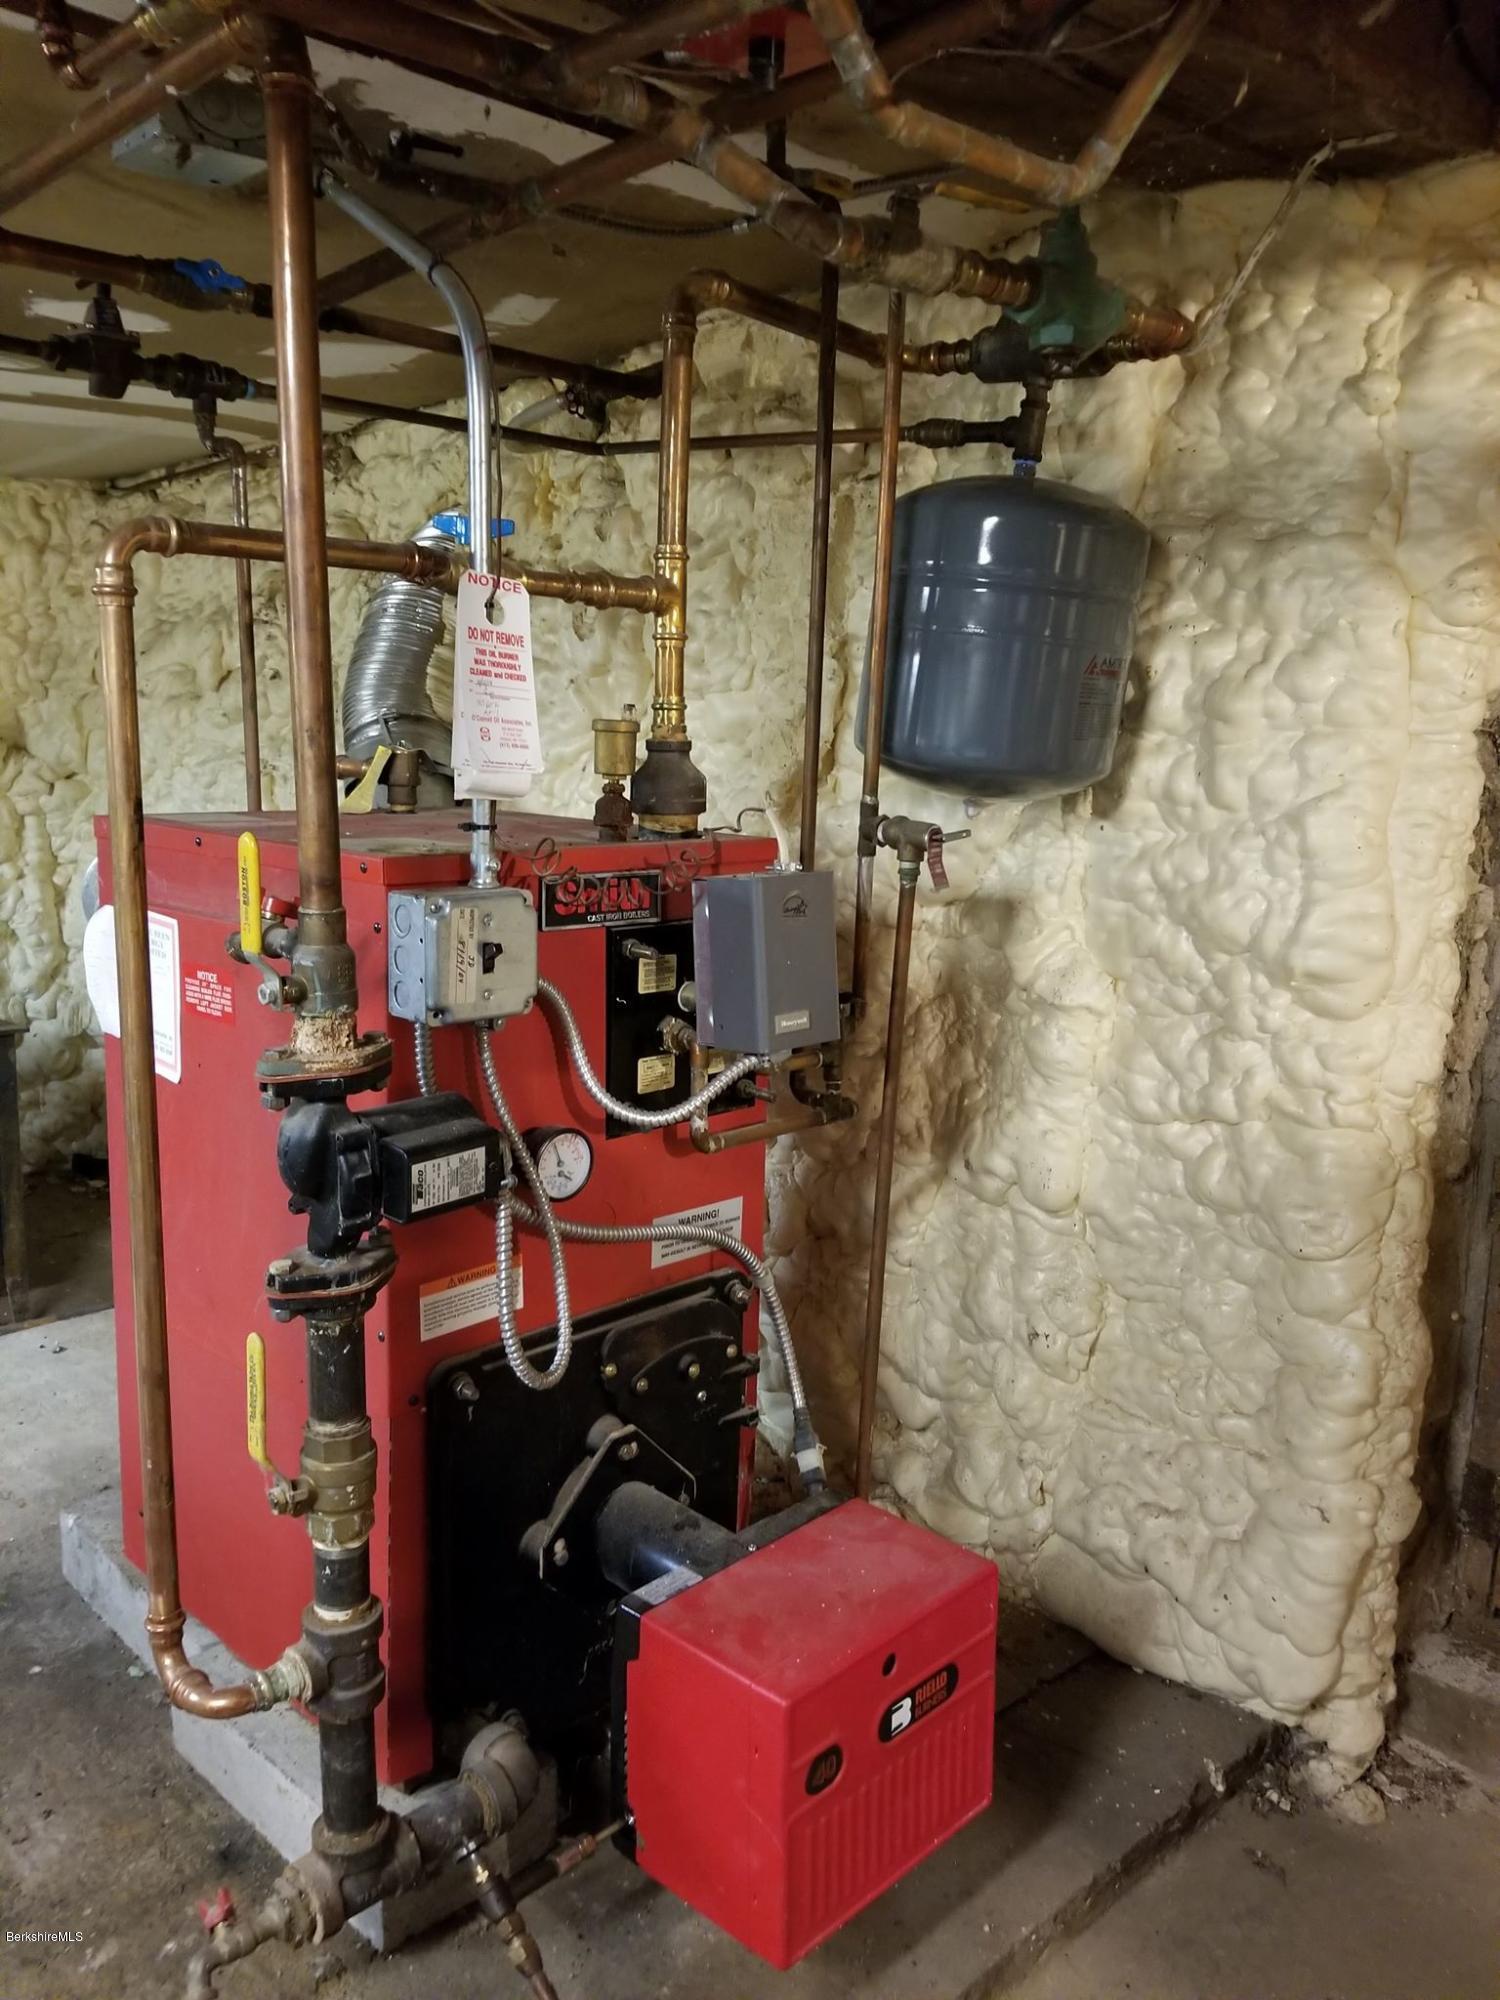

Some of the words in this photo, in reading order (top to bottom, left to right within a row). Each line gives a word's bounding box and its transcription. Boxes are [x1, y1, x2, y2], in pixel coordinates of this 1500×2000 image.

[468, 626, 479, 640] DO
[480, 629, 494, 642] NOT
[495, 631, 525, 648] REMOVE
[475, 647, 488, 656] THIS
[474, 658, 487, 667] WAS
[469, 667, 493, 678] CLEANED
[241, 866, 250, 907] BOSTON
[587, 914, 605, 923] CAST
[605, 912, 622, 921] IRON
[622, 909, 651, 920] BOILERS
[196, 970, 218, 983] NOTICE
[678, 1208, 720, 1226] WARNING!
[457, 1264, 497, 1286] WARNING
[915, 1671, 948, 1705] RIELLO
